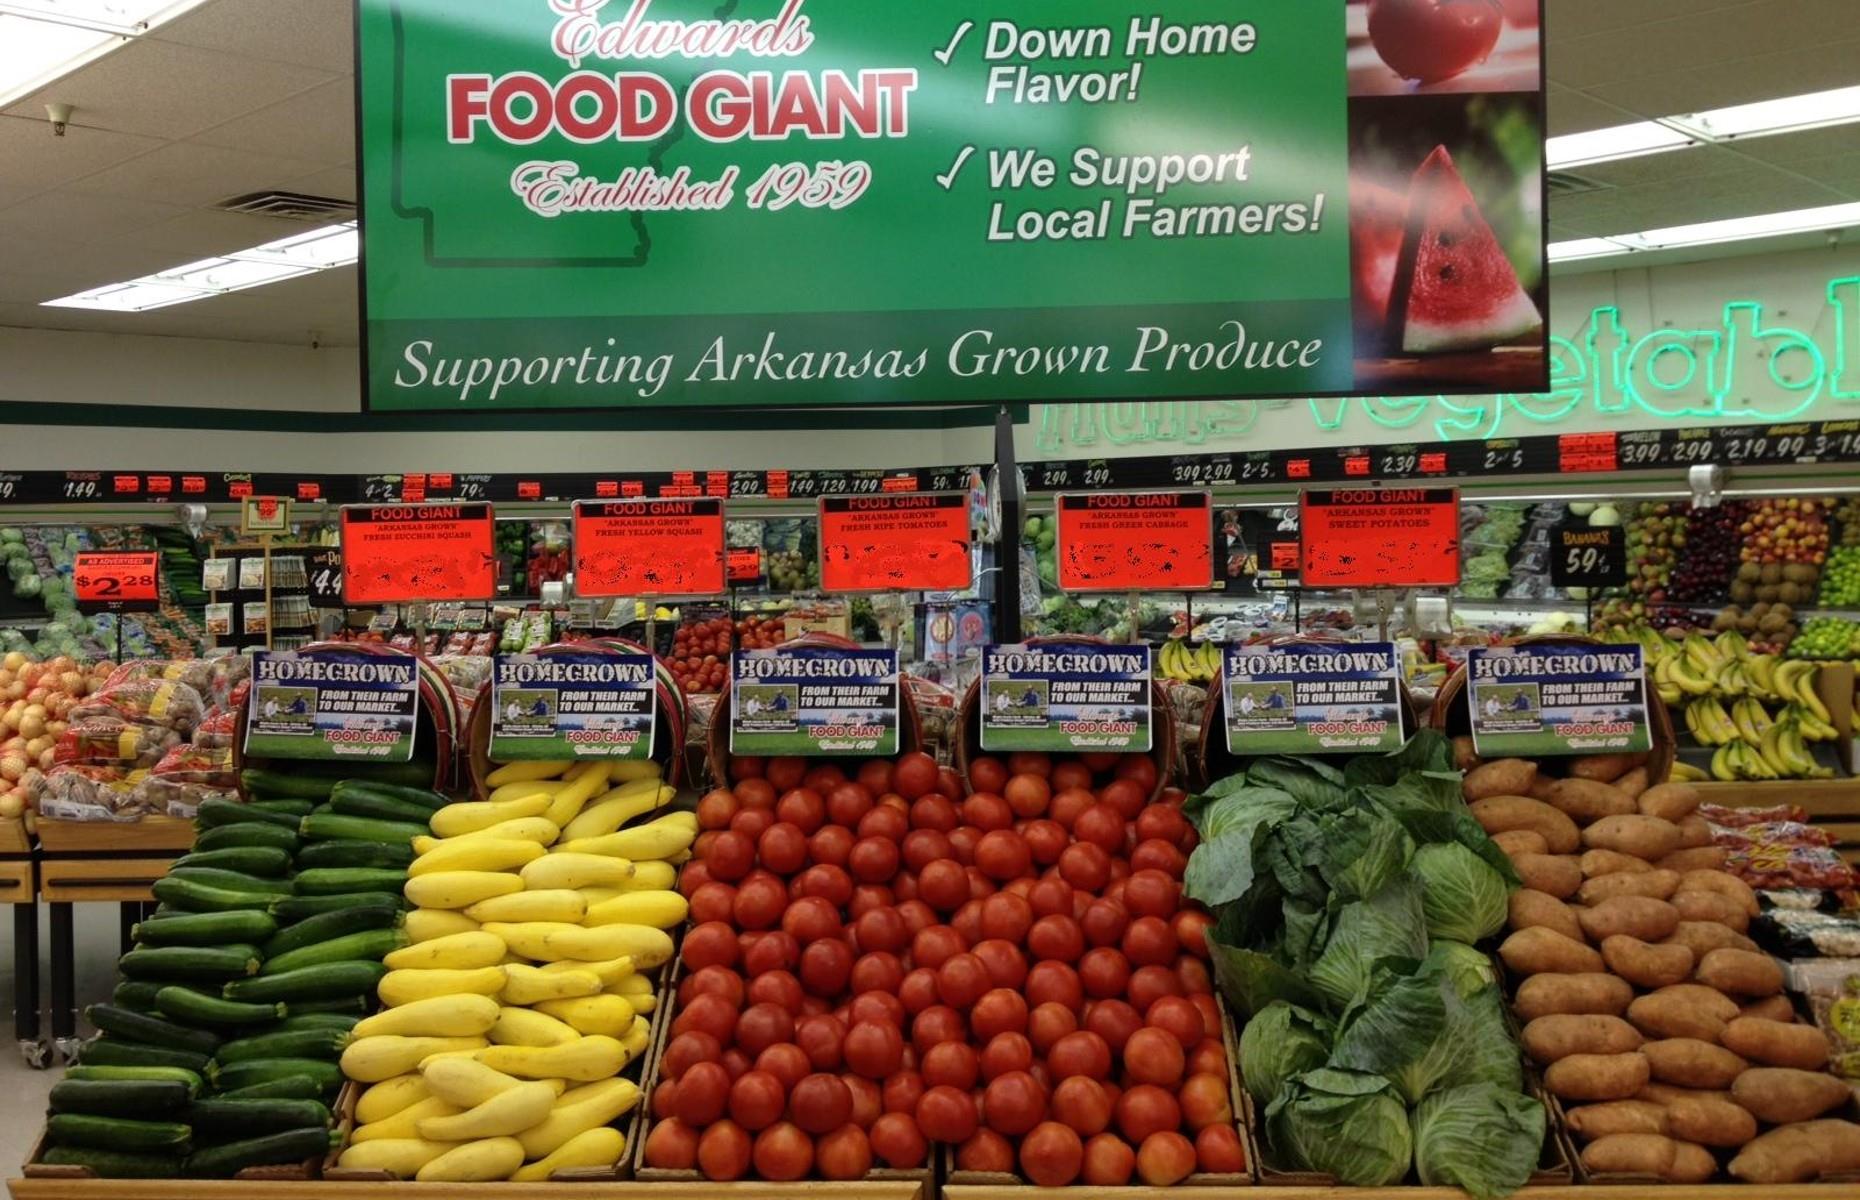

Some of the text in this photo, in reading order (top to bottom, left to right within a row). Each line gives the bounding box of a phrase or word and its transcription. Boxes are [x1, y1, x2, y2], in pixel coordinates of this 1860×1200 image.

[549, 0, 814, 68] Edwards
[984, 19, 1256, 60] Down Home
[985, 64, 1141, 105] Flavor!
[447, 69, 917, 144] FOOD GIANT
[989, 145, 1251, 195] We Support
[511, 161, 871, 217] Established 1959
[988, 194, 1324, 241] Local Farmers!
[395, 321, 1322, 400] Supporting Arkansas Grown Produce
[849, 497, 937, 509] FOOD GIANT
[1088, 494, 1180, 507] FOOD GIANT
[1332, 490, 1427, 503] FOOD GIANT
[372, 507, 461, 520] FOOD GIANT
[604, 502, 694, 515] FOOD GIANT
[841, 524, 871, 532] FRESH
[898, 521, 947, 529] TOMATOES
[1329, 519, 1430, 529] SWEET POTATOES
[739, 659, 890, 677] HOMEGROWN
[988, 654, 1142, 673] HOMEGROWN
[1230, 653, 1389, 675] HOMEGROWN
[1475, 653, 1635, 677] HOMEGROWN
[259, 661, 410, 684] HOMEGROWN
[500, 664, 648, 682] HOMEGROWN
[802, 686, 889, 696] FROM THEIR FARM
[1052, 682, 1141, 692] FROM THEIR FARM
[1297, 681, 1388, 692] FROM THEIR FARM
[1543, 682, 1635, 694] FROM THEIR FARM
[321, 690, 408, 702] FROM THEIR FARM
[561, 691, 646, 701] FROM THEIR FARM
[801, 697, 814, 706] TO
[815, 697, 836, 706] OUR
[1051, 693, 1065, 702] TO
[1066, 693, 1087, 702] OUR
[1296, 694, 1310, 703] TO
[1311, 693, 1334, 703] OUR
[1542, 695, 1556, 705] TO
[1557, 694, 1580, 704] OUR
[319, 700, 332, 711] TO
[334, 701, 355, 711] OUR
[559, 702, 573, 711] TO
[574, 702, 594, 711] OUR
[808, 725, 846, 738] FOOD
[848, 725, 885, 738] GIANT
[1060, 721, 1138, 735] FOOD GIANT
[1308, 722, 1346, 735] FOOD
[1348, 721, 1387, 735] GIANT
[1555, 723, 1595, 737] FOOD
[1596, 722, 1635, 736] GIANT
[324, 729, 400, 744] FOOD GIANT
[565, 731, 640, 744] FOOD GIANT
